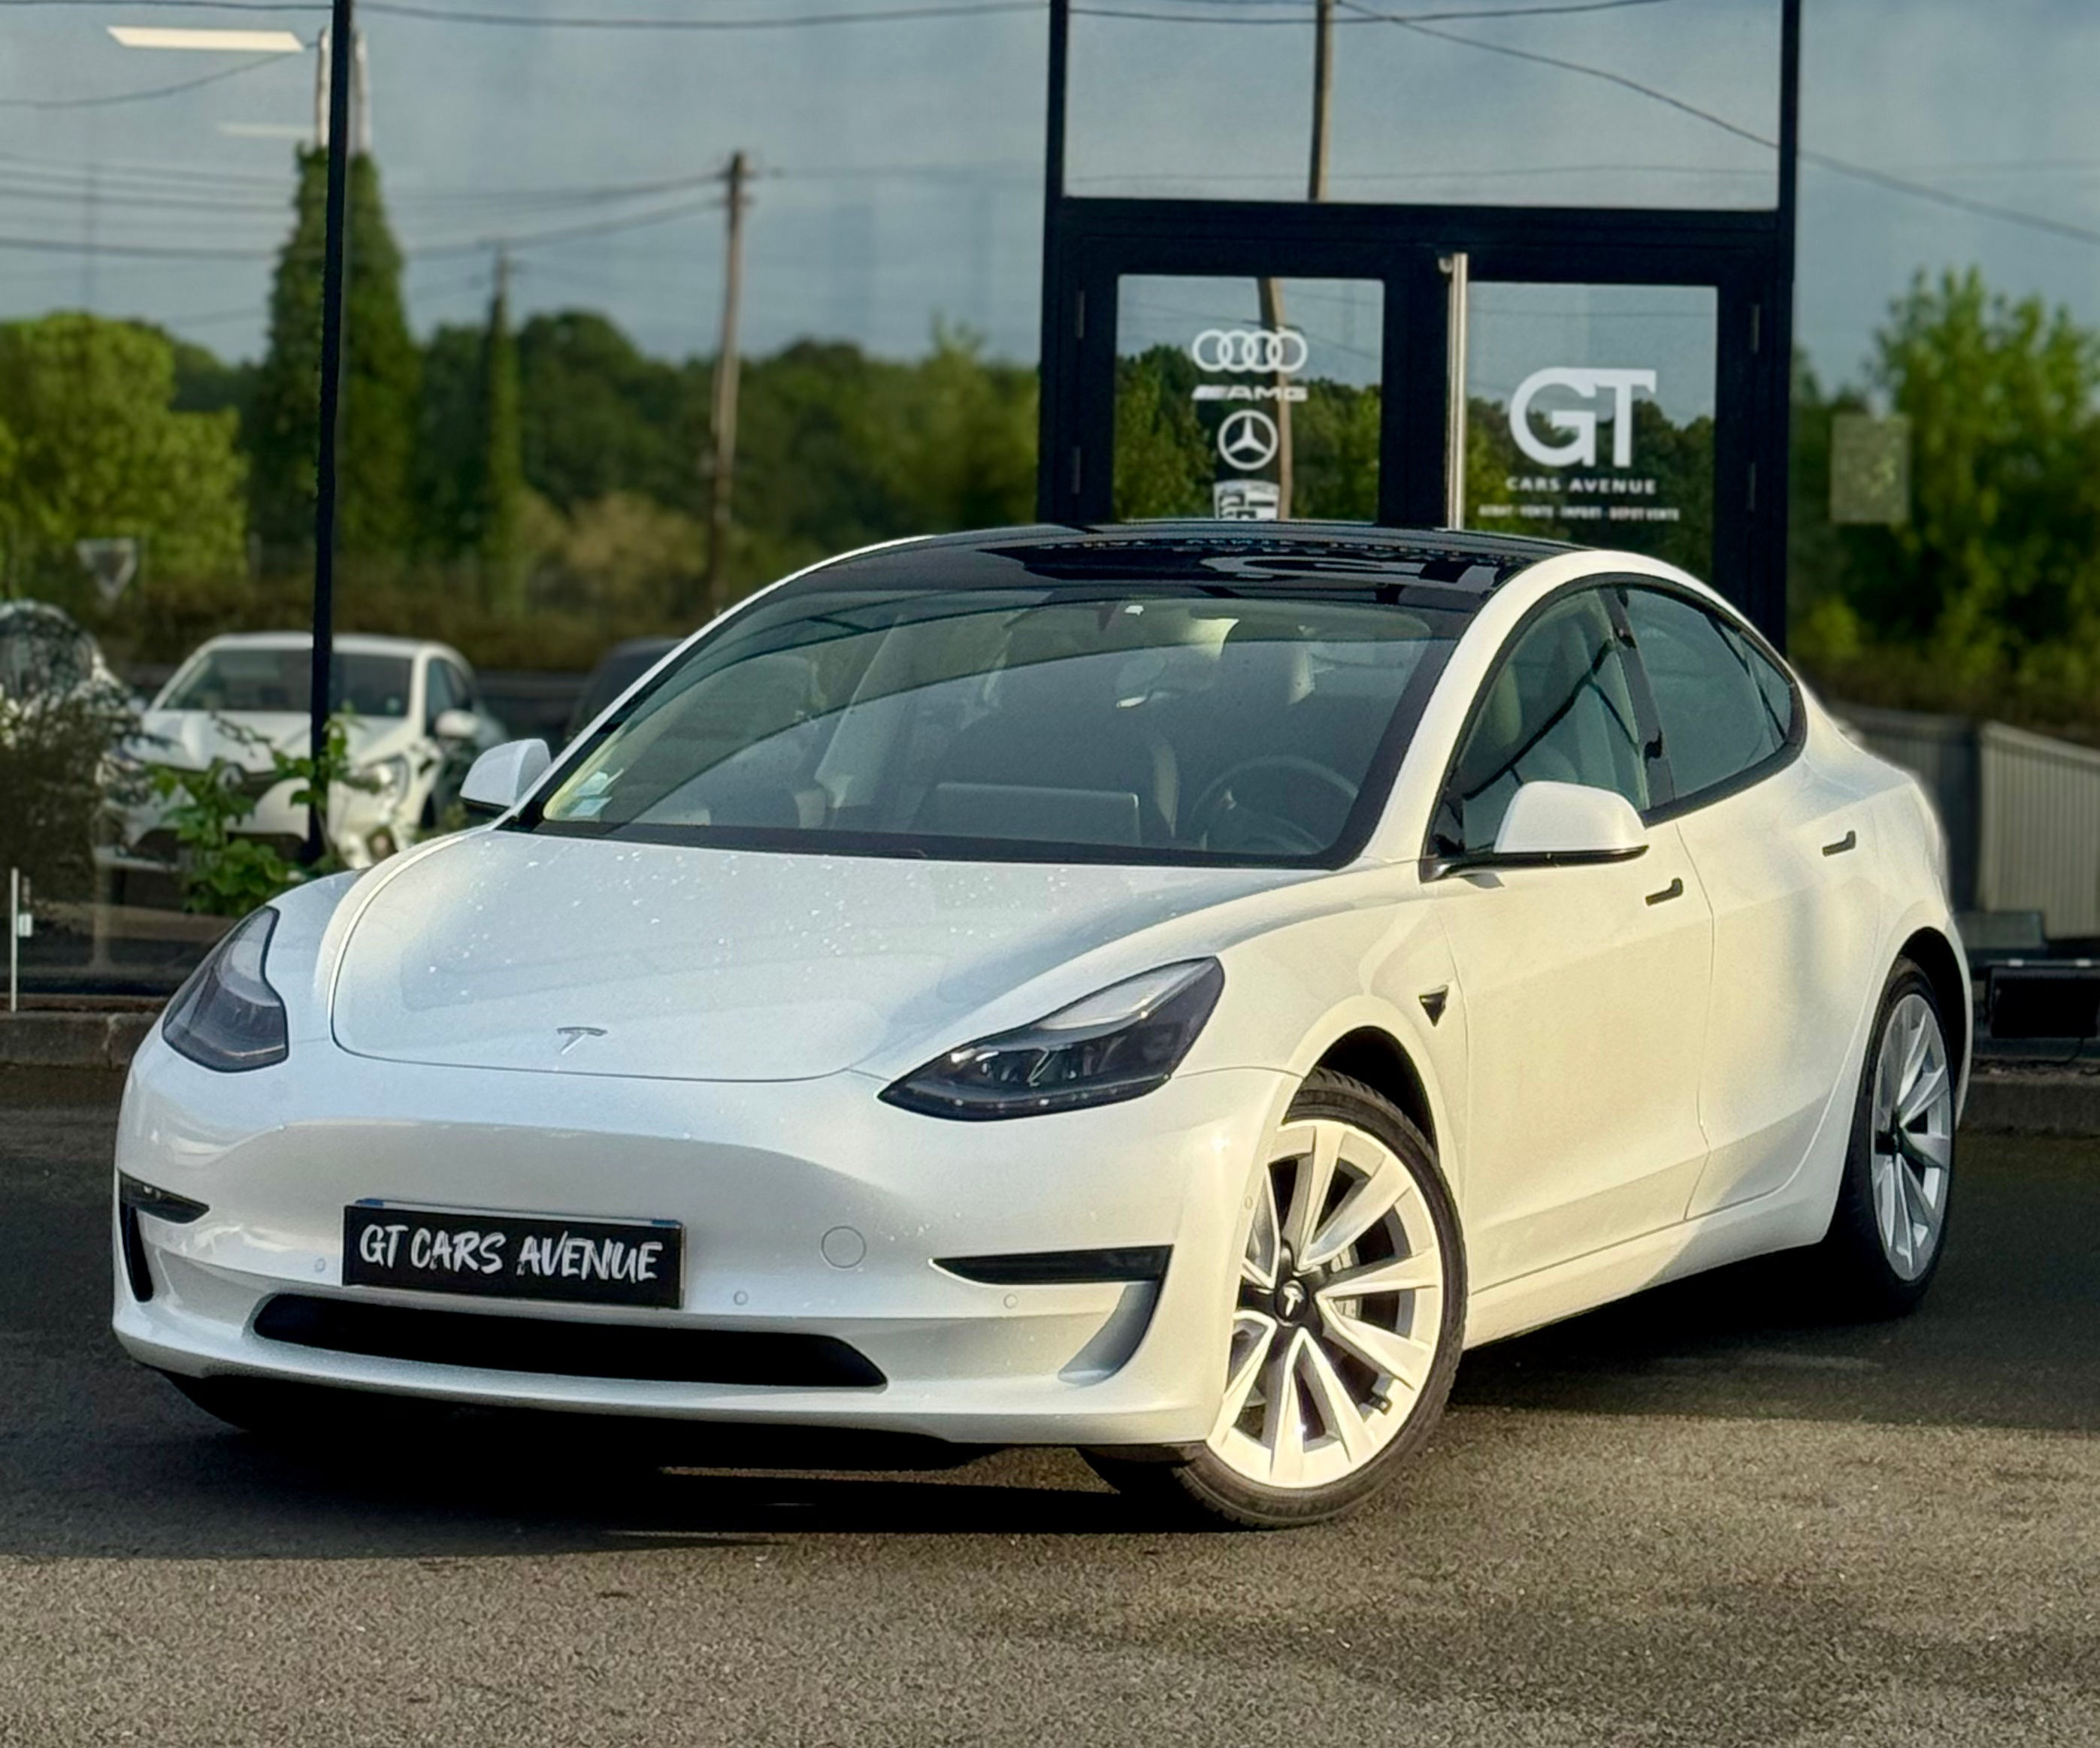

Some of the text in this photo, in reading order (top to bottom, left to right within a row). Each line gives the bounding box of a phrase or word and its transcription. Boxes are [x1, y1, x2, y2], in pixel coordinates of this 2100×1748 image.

[1227, 385, 1309, 402] AMG
[1509, 367, 1657, 467] GT
[1505, 476, 1657, 495] CARS AVENUE
[360, 1223, 664, 1284] GT CARS AVENUE
